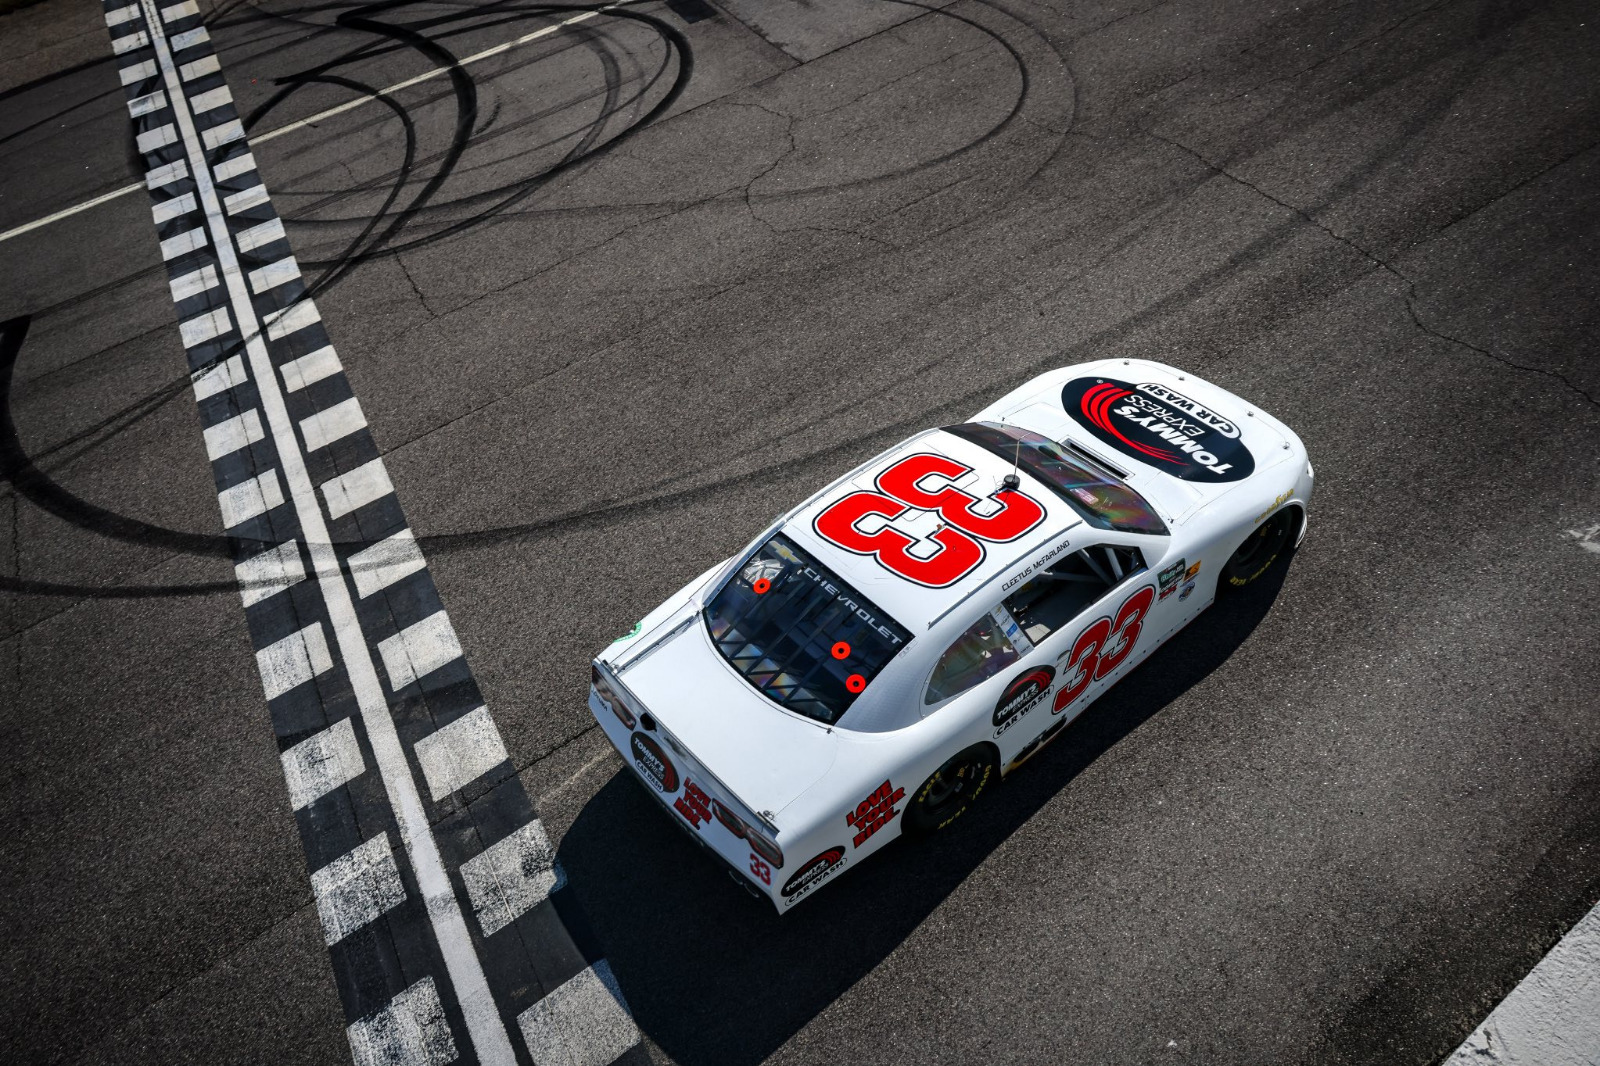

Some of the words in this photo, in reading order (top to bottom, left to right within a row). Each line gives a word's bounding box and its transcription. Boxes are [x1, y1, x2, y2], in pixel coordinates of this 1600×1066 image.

[1124, 394, 1206, 437] EXPRESS
[1142, 384, 1196, 411] WASH
[1114, 405, 1233, 475] TOMMY'S
[1195, 409, 1234, 434] CAR
[813, 452, 1047, 589] 33
[1001, 566, 1033, 592] CLEETUS
[1032, 539, 1071, 570] McFARLAND
[803, 567, 904, 645] CHEVROLET
[1051, 584, 1157, 716] 33
[996, 715, 1018, 736] CAR
[1020, 688, 1051, 717] WASH
[997, 682, 1038, 720] TOMMY'S
[634, 737, 665, 772] TOMMY'S
[636, 761, 648, 776] CAR
[647, 772, 663, 791] WASH
[683, 776, 712, 807] LOVE
[684, 789, 713, 825] YOUR
[845, 778, 893, 828] LOVE
[853, 786, 907, 832] YOUR
[749, 853, 772, 887] 33
[785, 859, 827, 892] TOMMY'S
[788, 884, 810, 903] CAR
[812, 860, 844, 885] WASH
